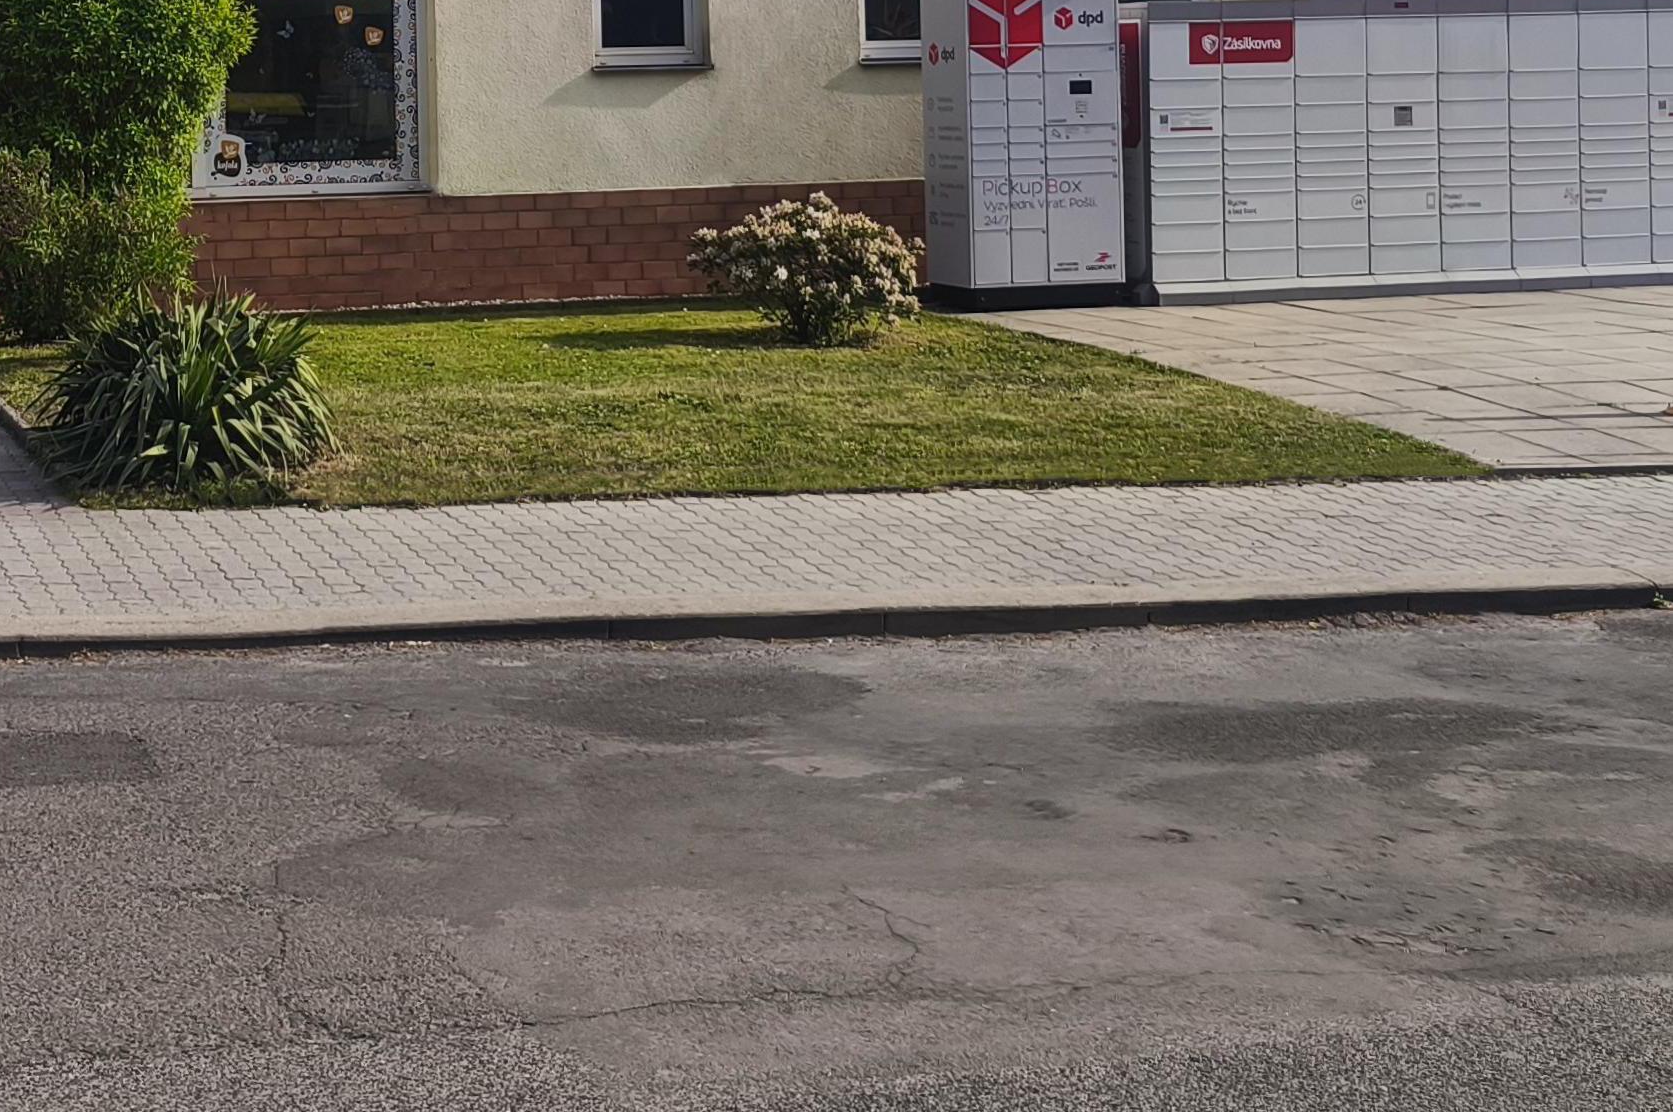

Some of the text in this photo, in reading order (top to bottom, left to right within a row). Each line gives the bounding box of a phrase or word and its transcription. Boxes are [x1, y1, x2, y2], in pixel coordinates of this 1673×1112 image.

[1078, 10, 1104, 27] dpd
[1223, 36, 1281, 50] Zásilkovna
[941, 47, 955, 64] dpd
[982, 178, 1043, 197] Pickup
[1046, 178, 1083, 195] Box
[983, 215, 1009, 226] 24/7
